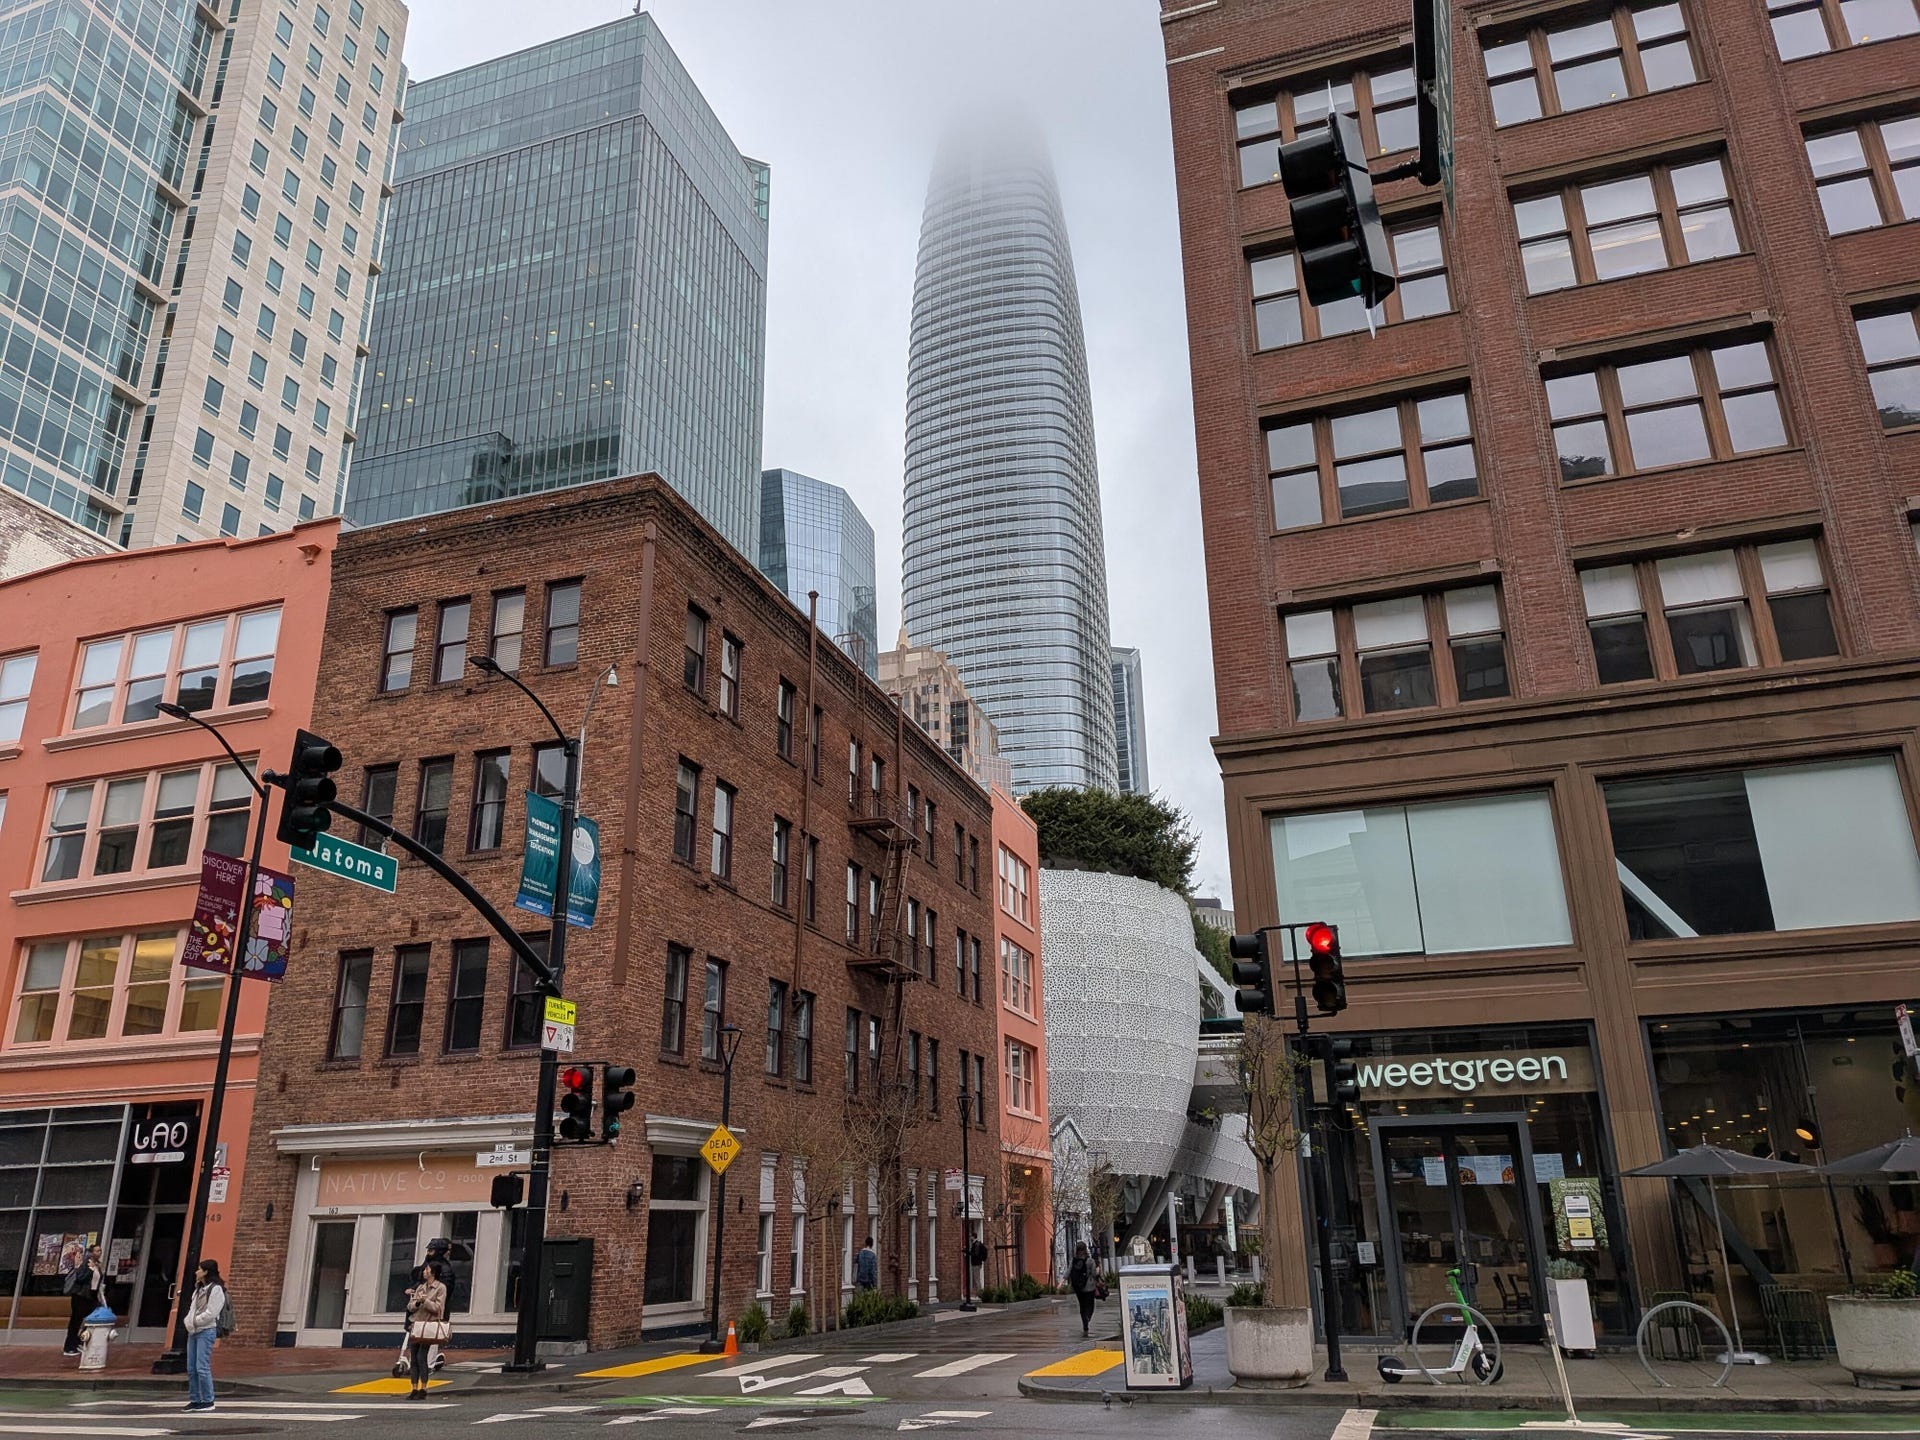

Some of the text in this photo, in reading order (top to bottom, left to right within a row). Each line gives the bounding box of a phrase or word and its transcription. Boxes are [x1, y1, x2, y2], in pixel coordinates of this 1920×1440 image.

[530, 841, 555, 857] EDUCATION
[203, 855, 244, 876] DISCOVER
[216, 871, 237, 885] HERE
[189, 935, 203, 946] THE
[186, 943, 204, 953] EAST
[183, 950, 200, 960] CUT
[548, 1001, 566, 1011] TURNING
[1349, 1055, 1567, 1091] weetgreen
[134, 1121, 188, 1150] LAO
[710, 1139, 733, 1149] DEAD
[489, 1154, 518, 1164] 2nd St
[712, 1151, 729, 1161] END
[325, 1171, 409, 1193] NATIVE
[457, 1174, 484, 1183] FOOD
